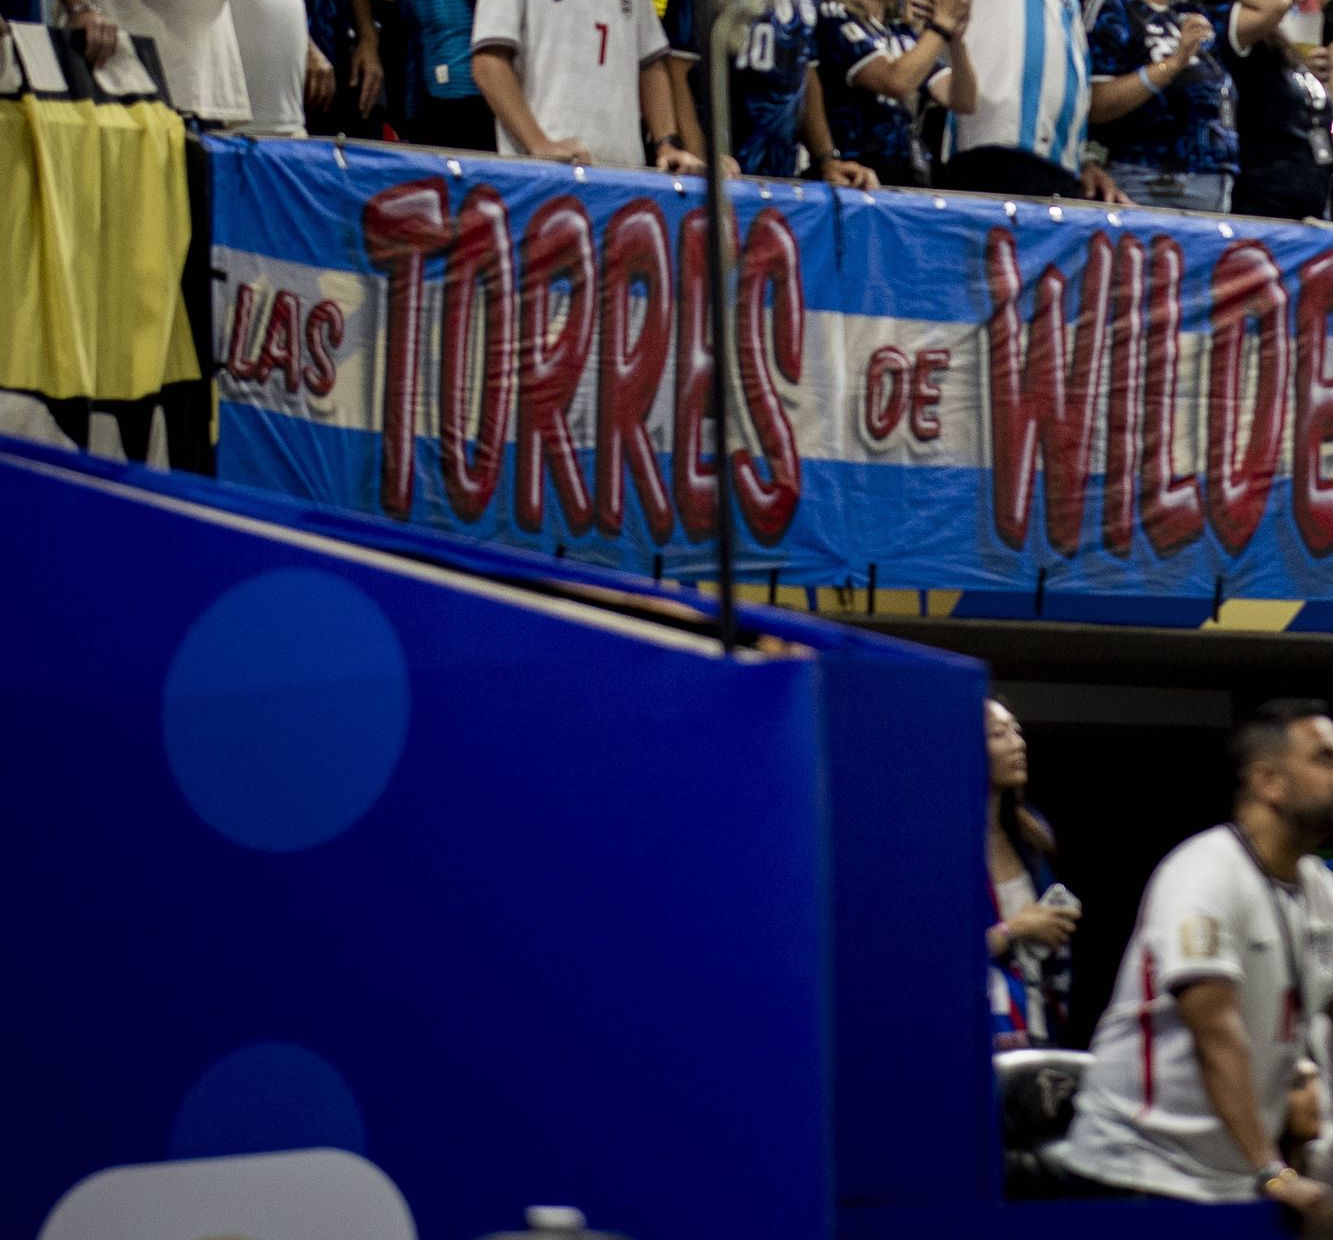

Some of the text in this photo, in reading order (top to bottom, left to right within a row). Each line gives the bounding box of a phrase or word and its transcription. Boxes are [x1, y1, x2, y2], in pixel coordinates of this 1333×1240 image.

[595, 23, 608, 66] 7
[225, 281, 345, 397] LAS
[363, 177, 807, 547] TORRES
[861, 343, 951, 445] DE
